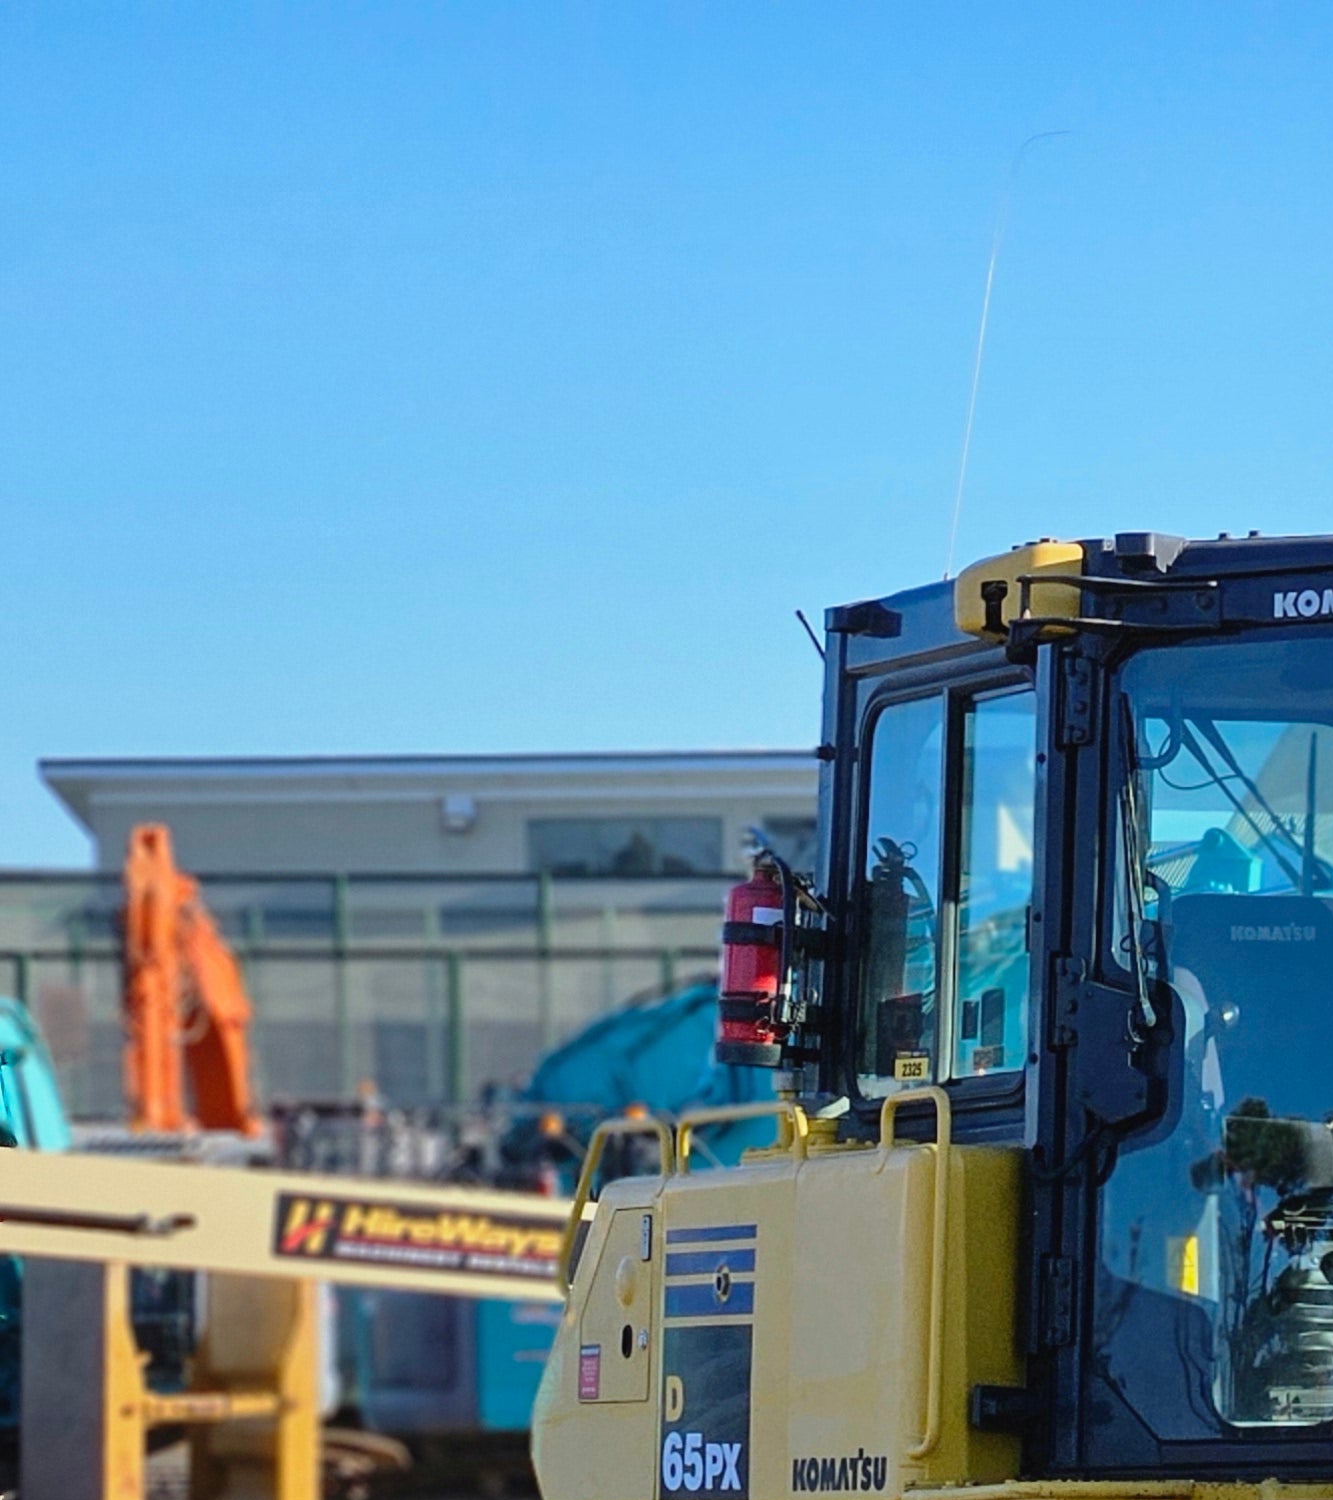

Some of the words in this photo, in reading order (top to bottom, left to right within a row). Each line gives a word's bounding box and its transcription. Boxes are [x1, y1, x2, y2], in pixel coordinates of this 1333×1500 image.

[1230, 922, 1317, 941] KOMATSU
[341, 1203, 561, 1257] HireWays
[665, 1375, 684, 1422] D
[663, 1431, 741, 1491] 65PX
[793, 1448, 887, 1492] KOMATSU
